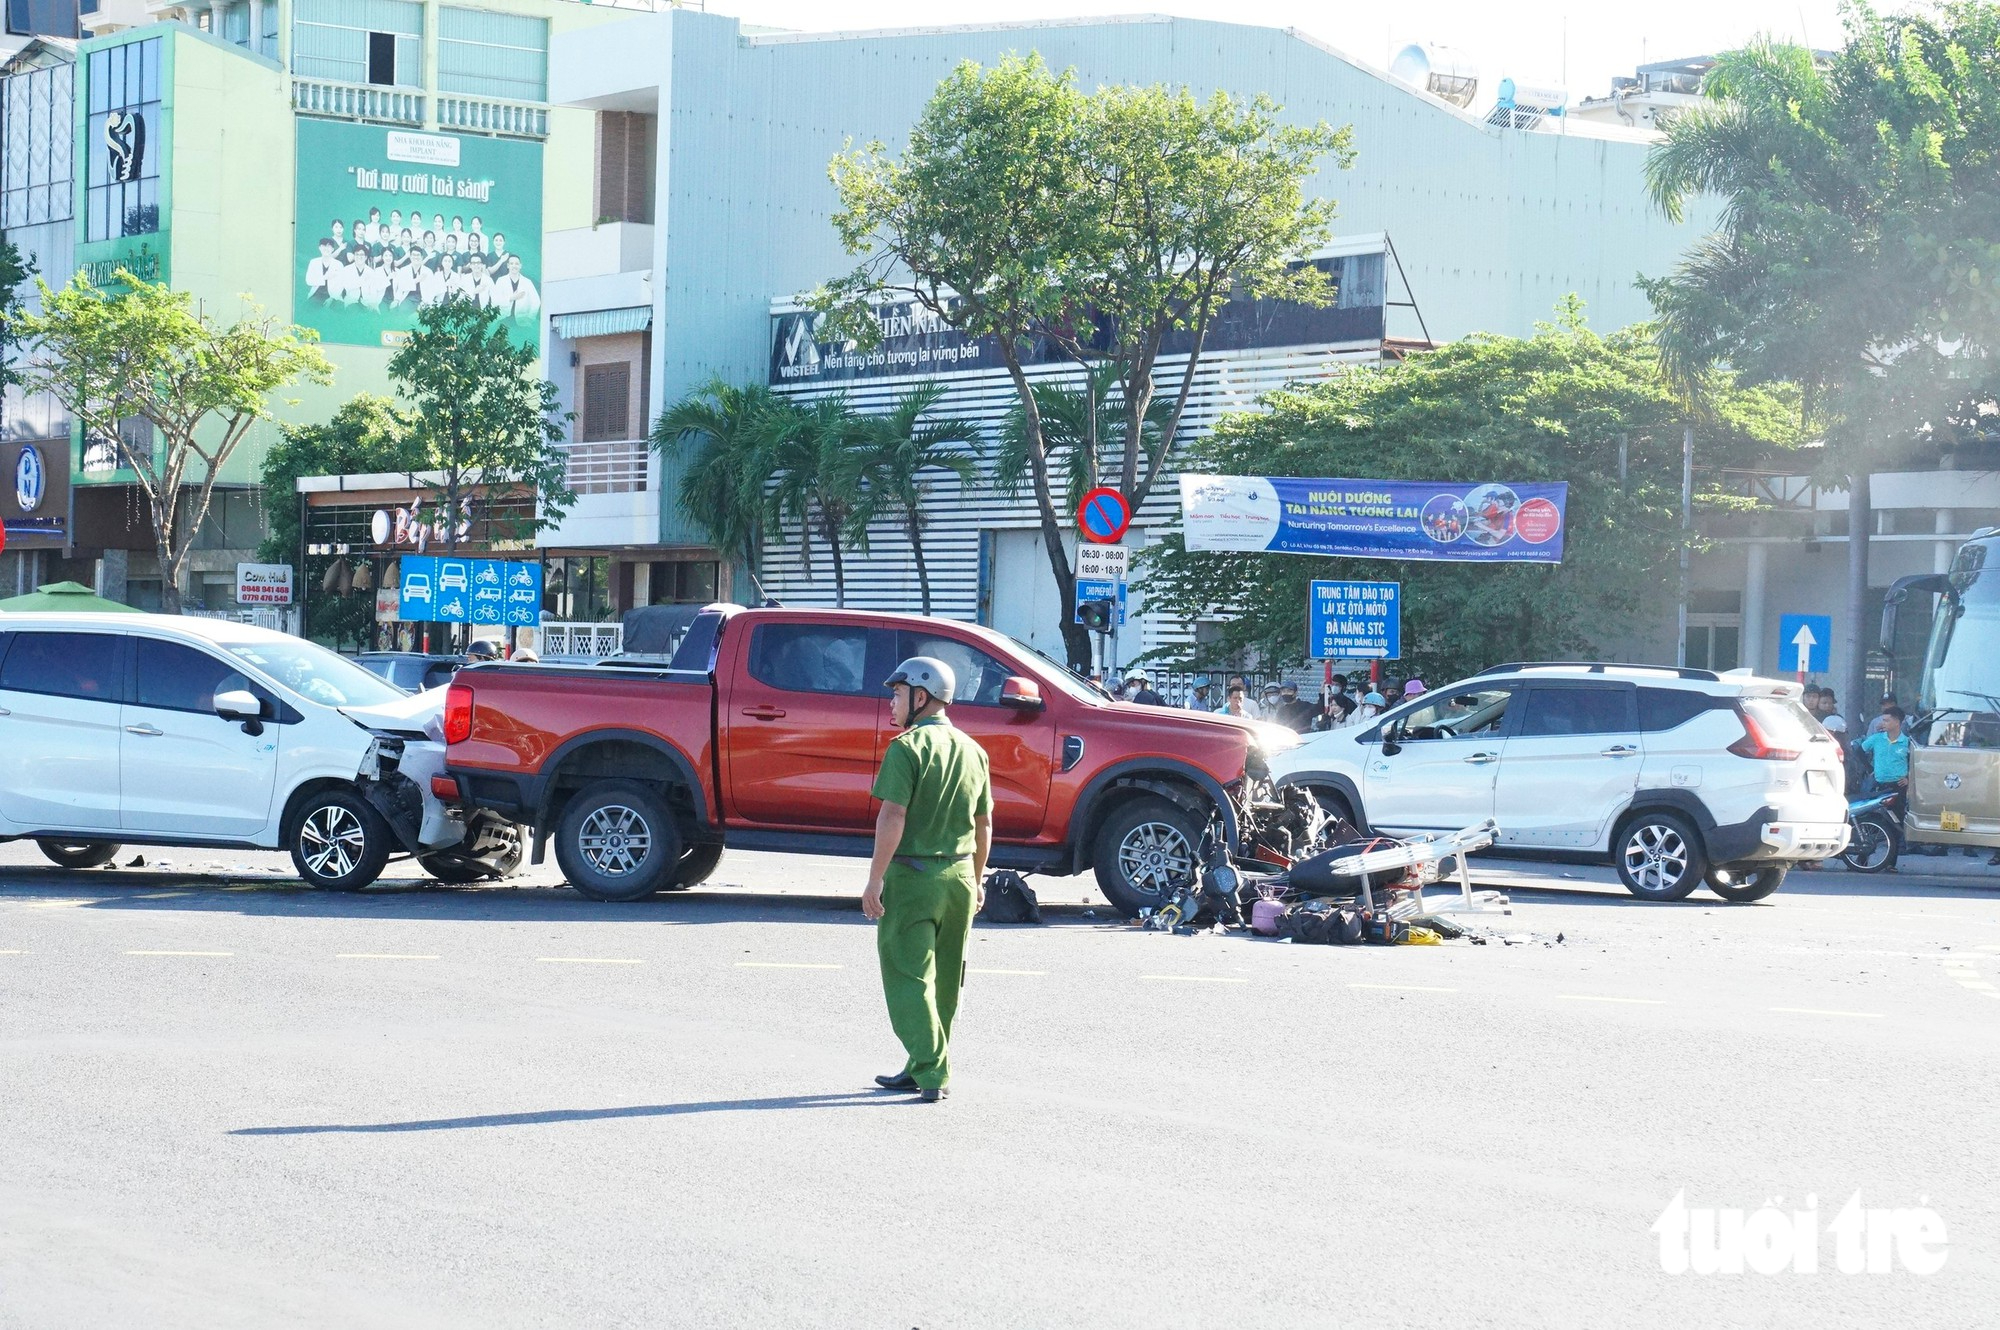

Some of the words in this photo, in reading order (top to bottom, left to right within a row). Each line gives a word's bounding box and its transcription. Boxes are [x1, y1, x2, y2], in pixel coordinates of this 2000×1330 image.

[867, 352, 885, 366] cho
[918, 346, 930, 362] lai
[932, 345, 958, 364] vững
[960, 340, 980, 359] bền
[1308, 490, 1342, 503] NUÔI
[1345, 491, 1392, 504] DƯỠNG
[1286, 501, 1307, 515] TÀI
[1310, 503, 1347, 516] NĂNG
[1348, 505, 1394, 518] TƯƠNG
[1396, 507, 1418, 518] LAI
[1288, 520, 1326, 532] Nurturing
[1374, 524, 1416, 533] Excellence
[1081, 549, 1100, 559] 06:30
[1105, 551, 1124, 560] 08:00
[1082, 565, 1099, 574] 16:00
[1105, 566, 1123, 575] 18:30
[241, 585, 260, 593] 0948
[1317, 587, 1341, 599] TRUNG
[1343, 585, 1360, 600] TÂM
[1362, 585, 1377, 600] ĐÀO
[1380, 588, 1394, 602] TẠO
[1322, 600, 1335, 615] LÁI
[1336, 603, 1346, 615] XE
[1326, 618, 1339, 635] ĐÀ
[1340, 616, 1365, 635] NẴNG
[1367, 622, 1385, 635] STC
[1323, 637, 1333, 646] 53
[1334, 638, 1353, 646] PHAN
[1354, 637, 1373, 646] ĐĂNG
[1323, 648, 1338, 656] 200
[1339, 648, 1346, 656] M
